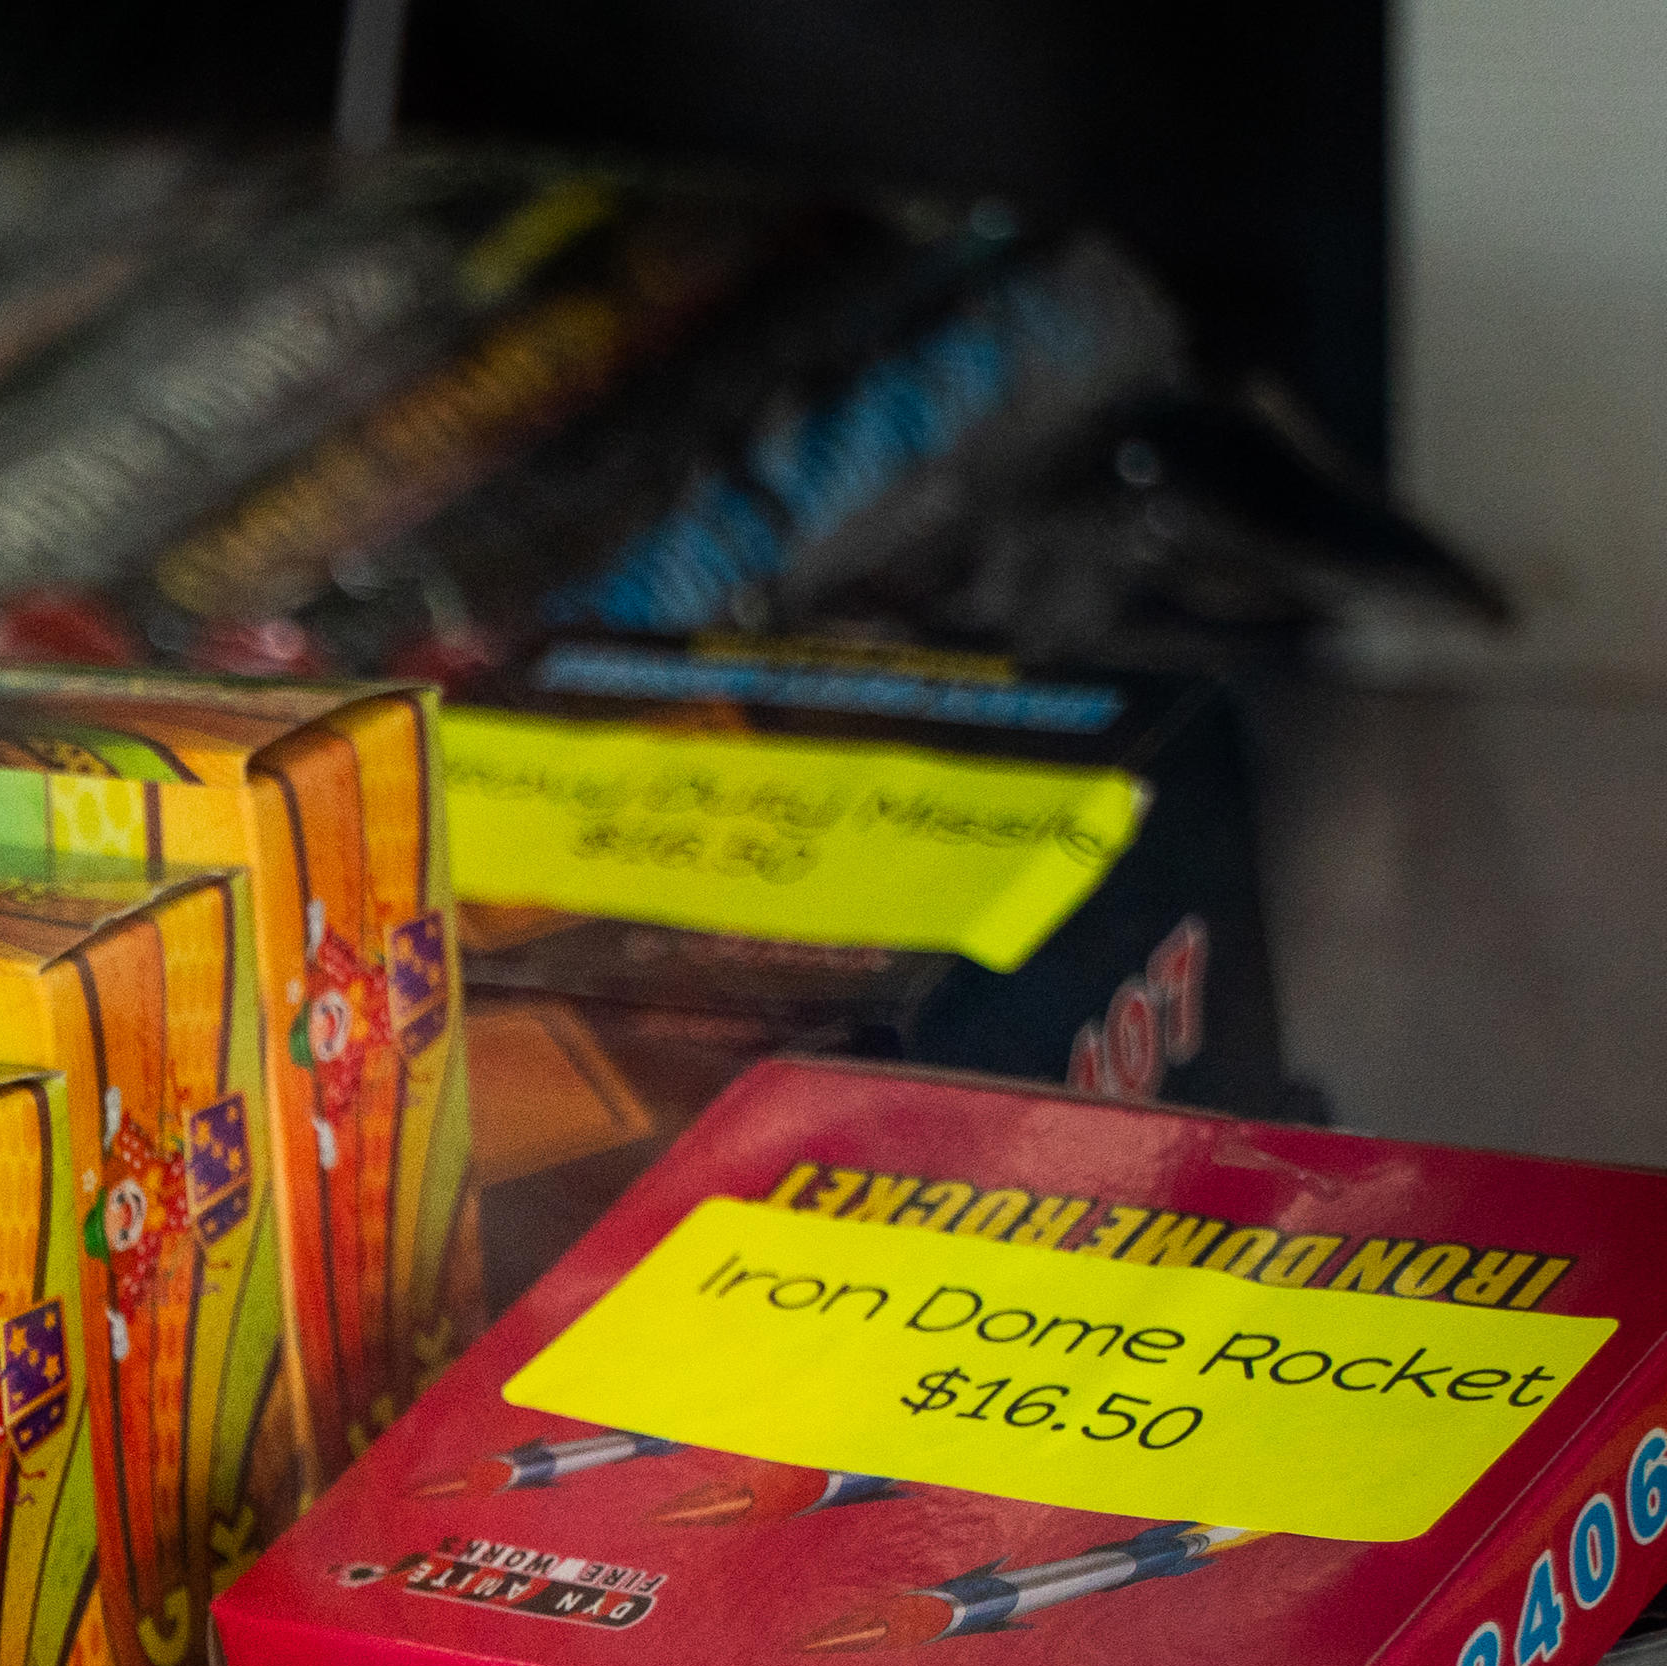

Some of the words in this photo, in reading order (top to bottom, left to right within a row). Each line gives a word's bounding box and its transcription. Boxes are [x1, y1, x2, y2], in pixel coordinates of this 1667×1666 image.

[1346, 1232, 1579, 1310] IRON
[698, 1250, 894, 1323] Iron
[904, 1282, 1189, 1366] Dome
[1198, 1328, 1556, 1409] Rocket
[900, 1365, 1204, 1453] $16.50
